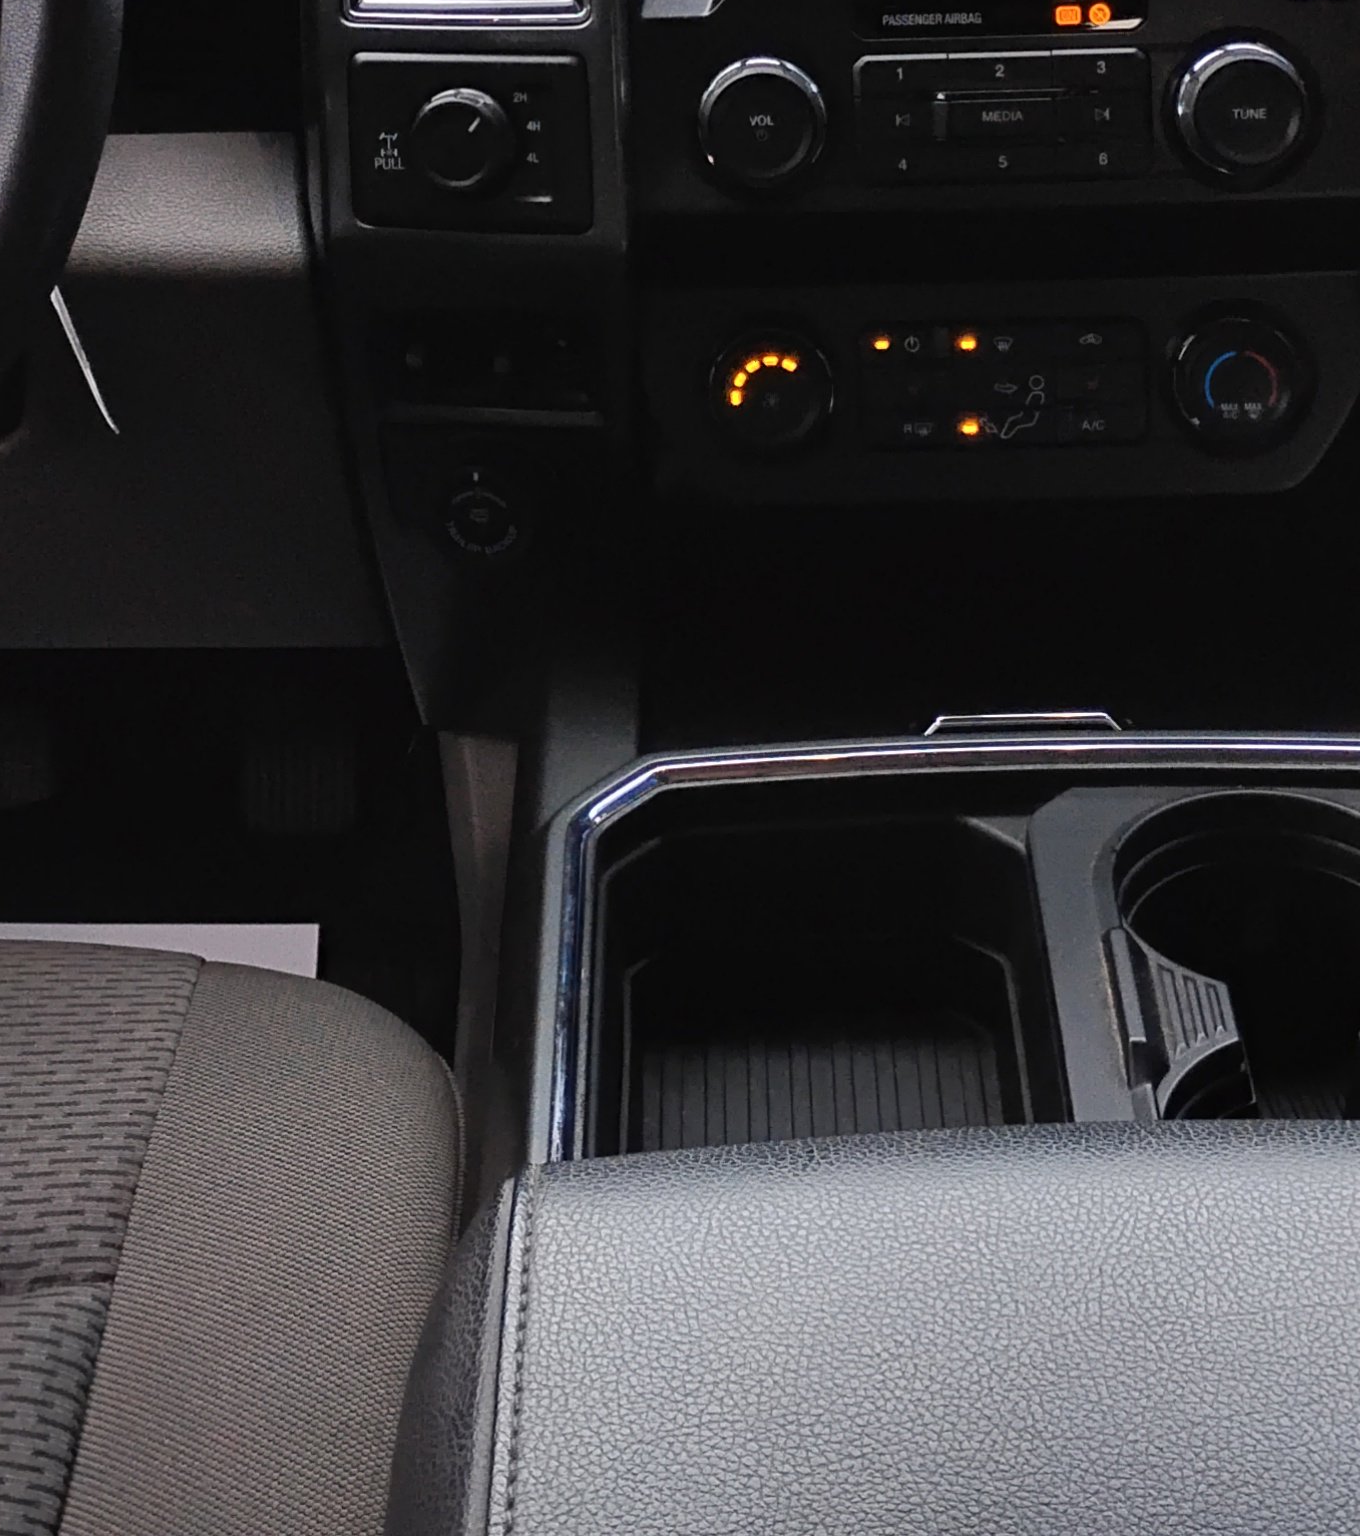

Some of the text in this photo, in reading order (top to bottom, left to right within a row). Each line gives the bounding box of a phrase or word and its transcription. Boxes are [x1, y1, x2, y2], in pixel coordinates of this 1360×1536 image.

[881, 12, 983, 27] PASSENGER AIRBAG
[896, 67, 904, 80] 1
[994, 65, 1006, 78] 2
[1096, 60, 1107, 74] 3
[512, 92, 528, 104] 2H
[981, 110, 1024, 123] MEDIA
[1231, 107, 1268, 120] TUNE
[525, 120, 541, 132] 4H
[749, 114, 775, 127] VOL
[374, 156, 406, 170] PULL
[525, 152, 540, 164] 4L
[896, 157, 908, 171] 4
[998, 154, 1008, 169] 5
[1097, 152, 1109, 166] 6
[1081, 418, 1105, 432] A/C
